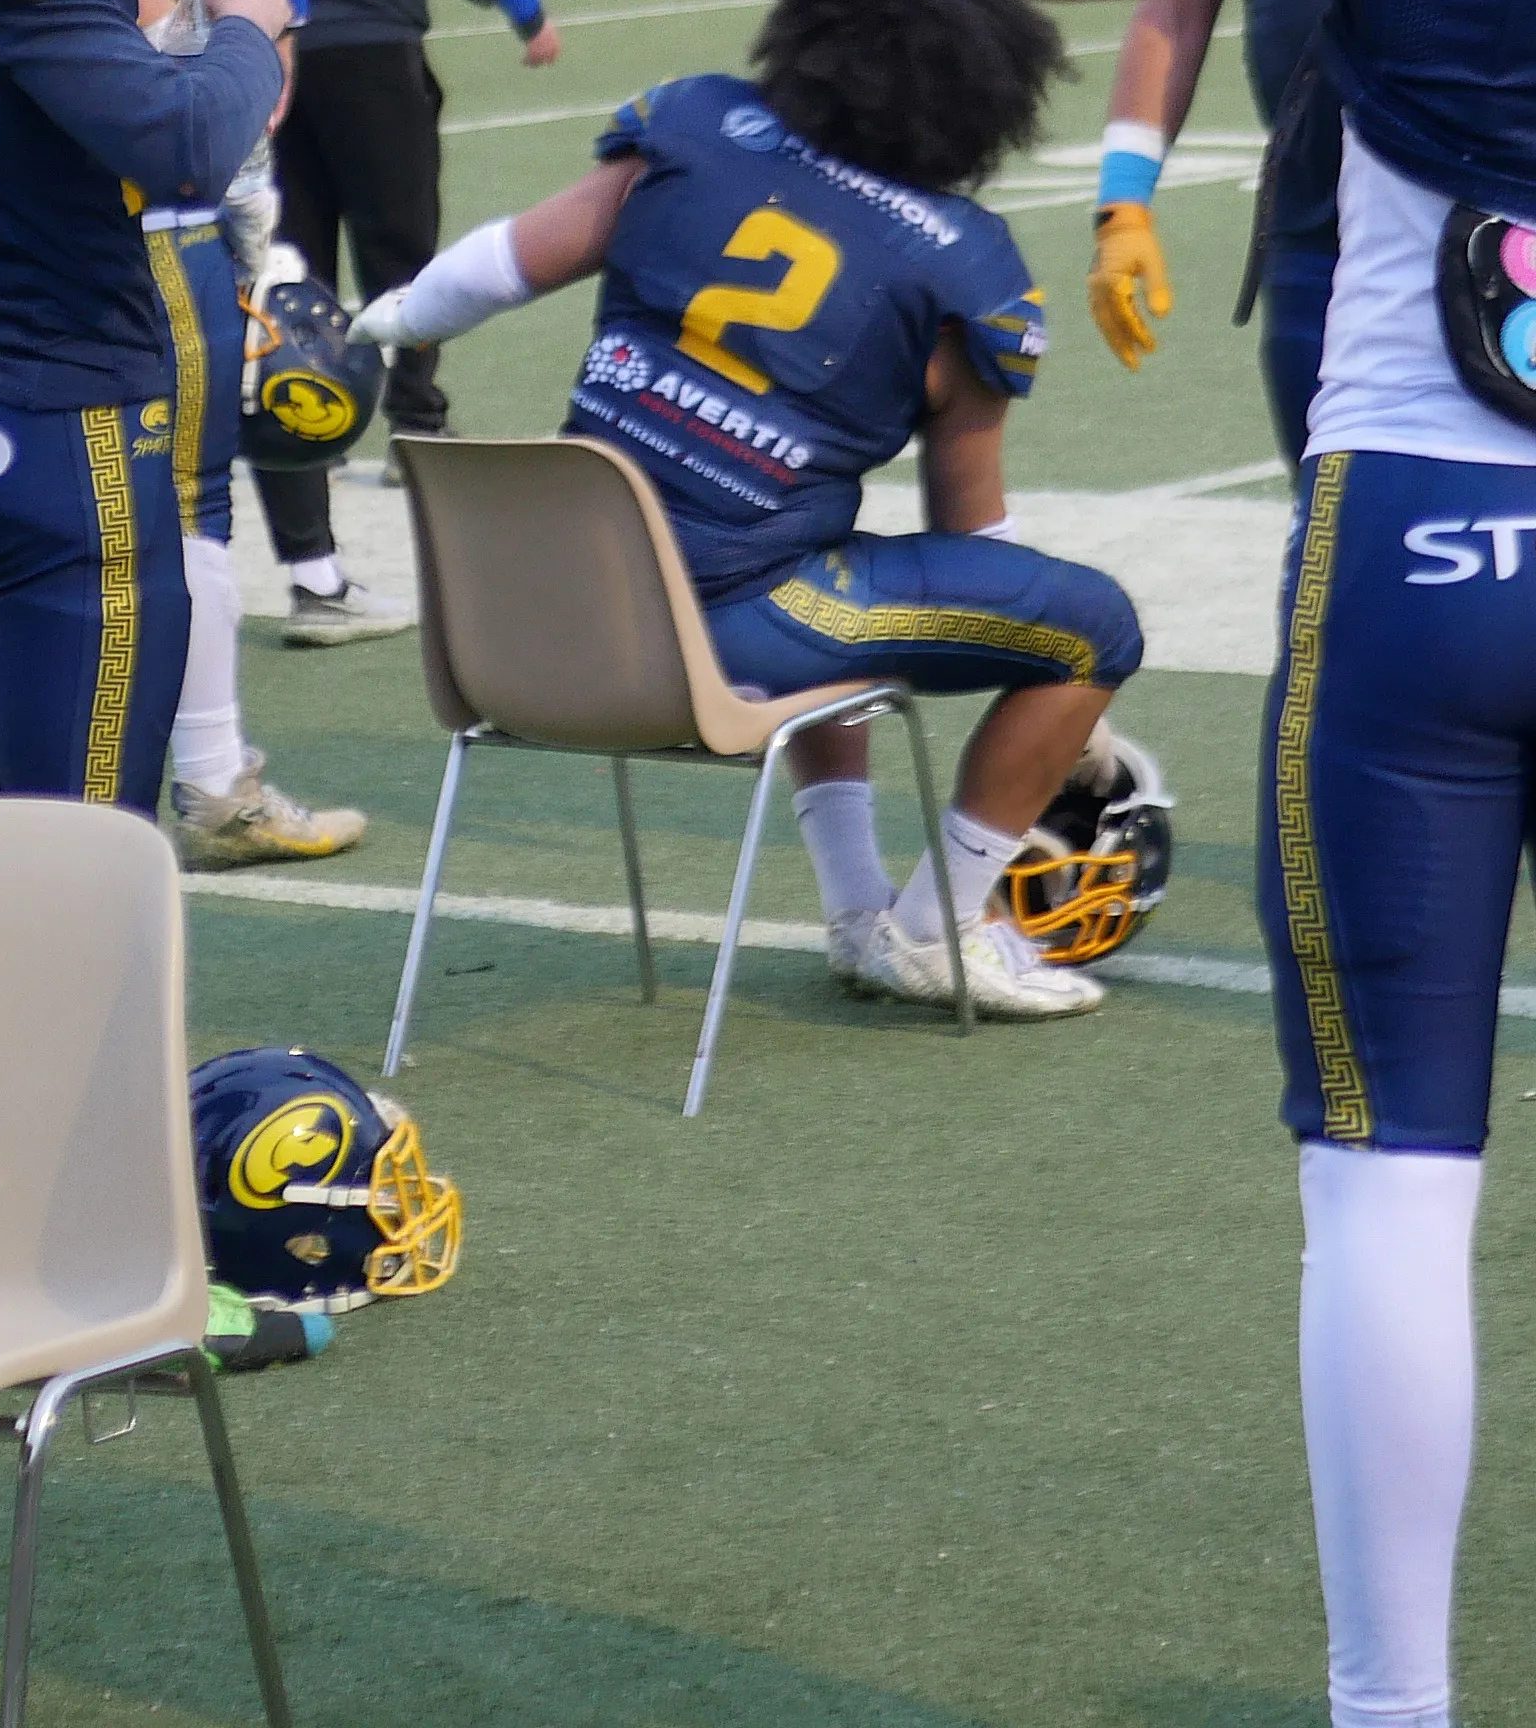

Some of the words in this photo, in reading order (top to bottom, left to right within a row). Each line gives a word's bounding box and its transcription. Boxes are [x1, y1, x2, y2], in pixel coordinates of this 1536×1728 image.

[781, 133, 963, 248] PLANCHON
[674, 205, 842, 397] 2
[650, 371, 812, 470] AVERTIS
